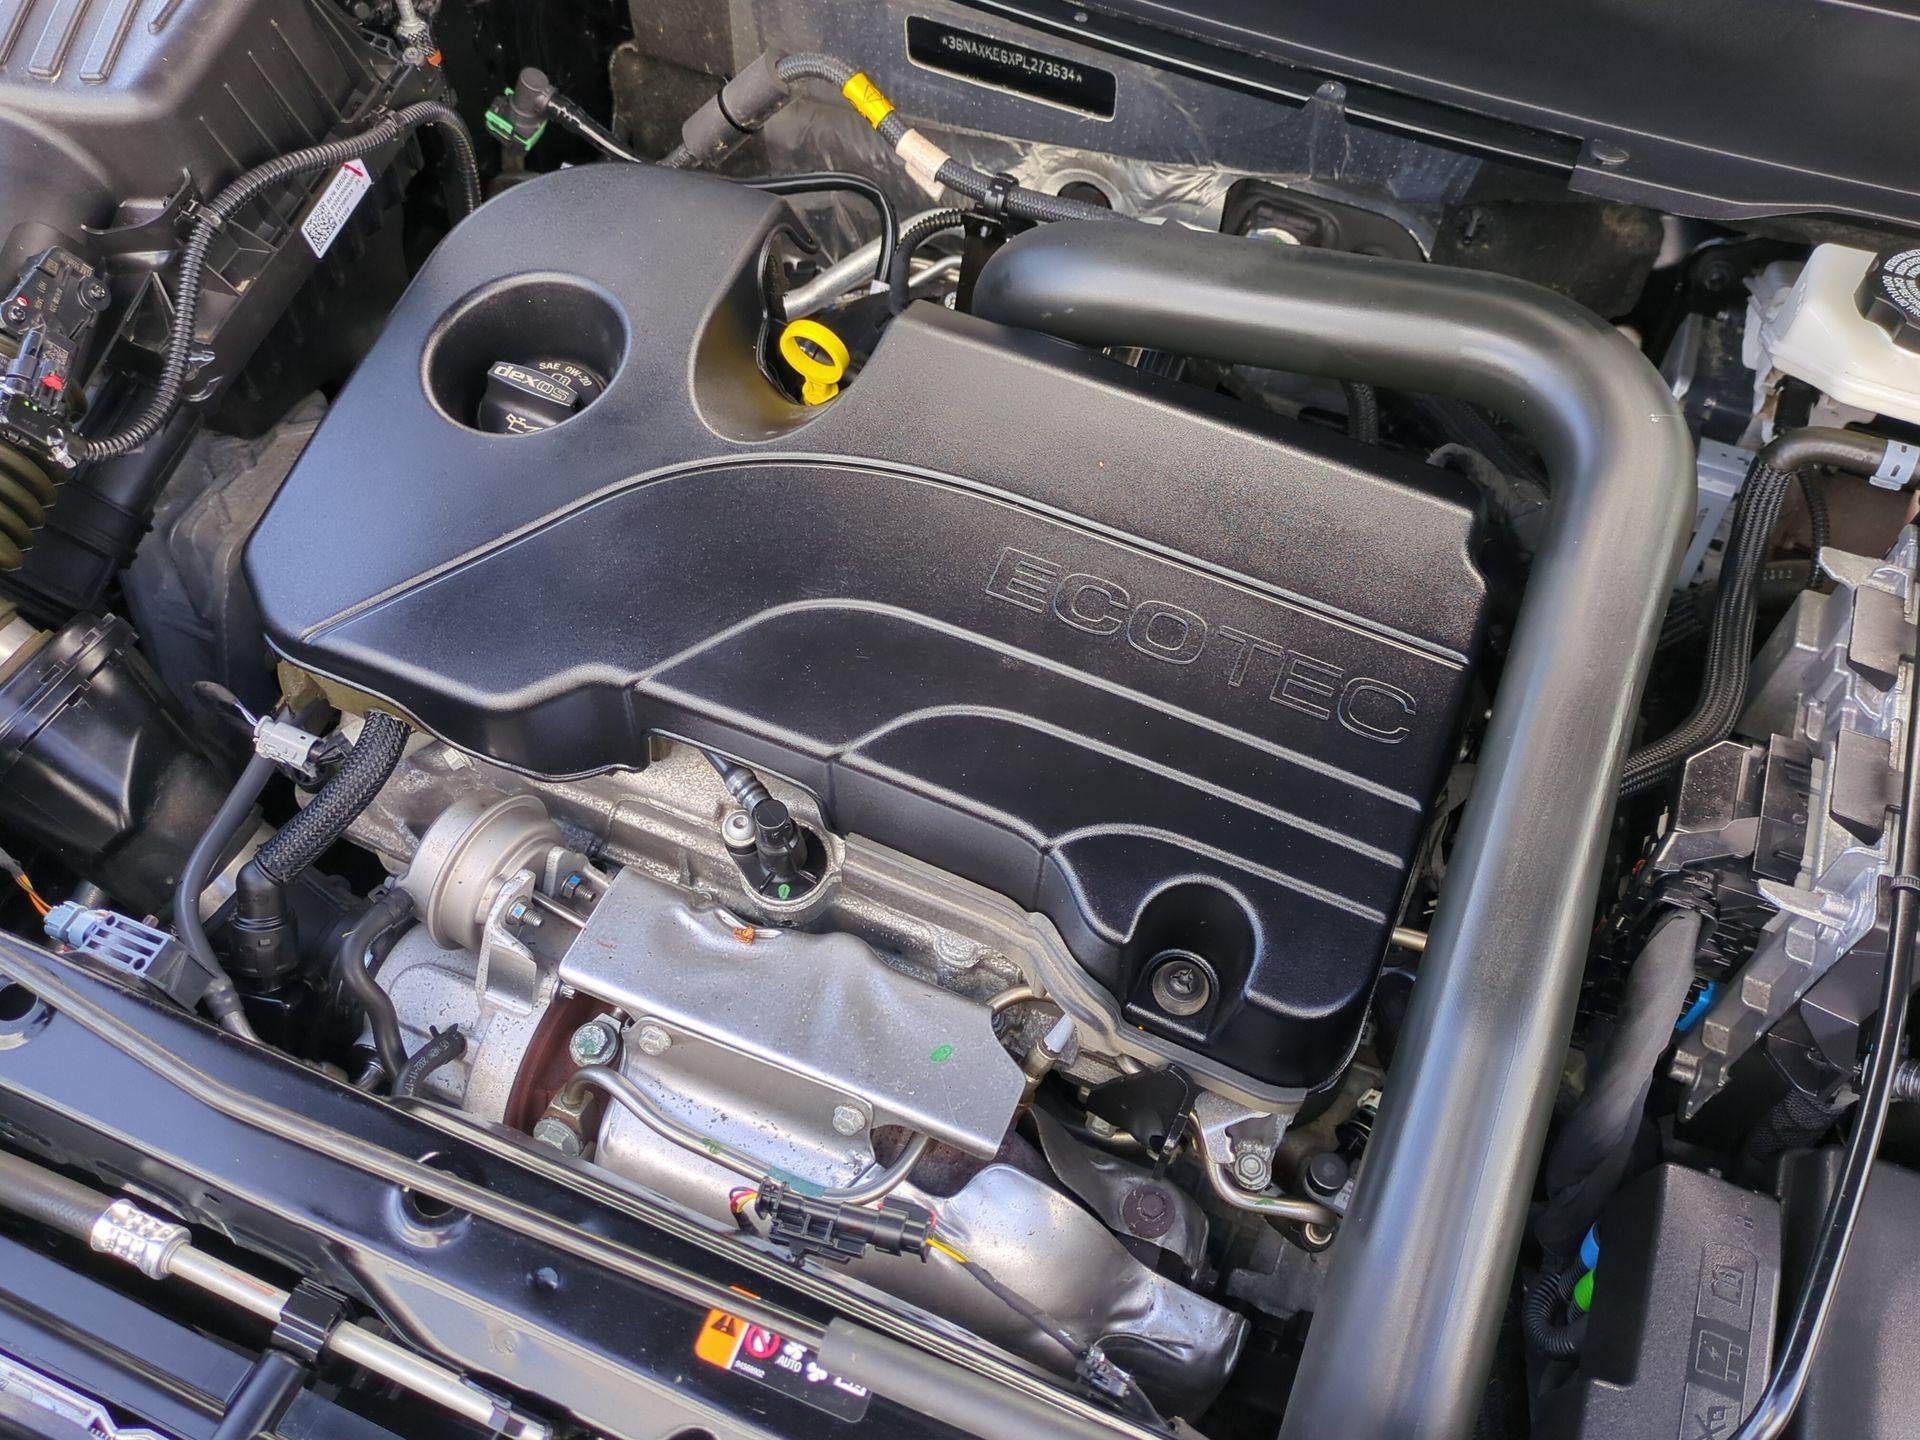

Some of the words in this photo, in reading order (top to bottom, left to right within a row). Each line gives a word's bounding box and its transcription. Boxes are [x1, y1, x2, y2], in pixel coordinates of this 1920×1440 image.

[494, 365, 569, 401] dexos
[538, 362, 561, 370] SAE
[565, 366, 593, 387] 0W-20
[984, 546, 1417, 745] ECOTEC
[775, 1356, 803, 1373] AUTO
